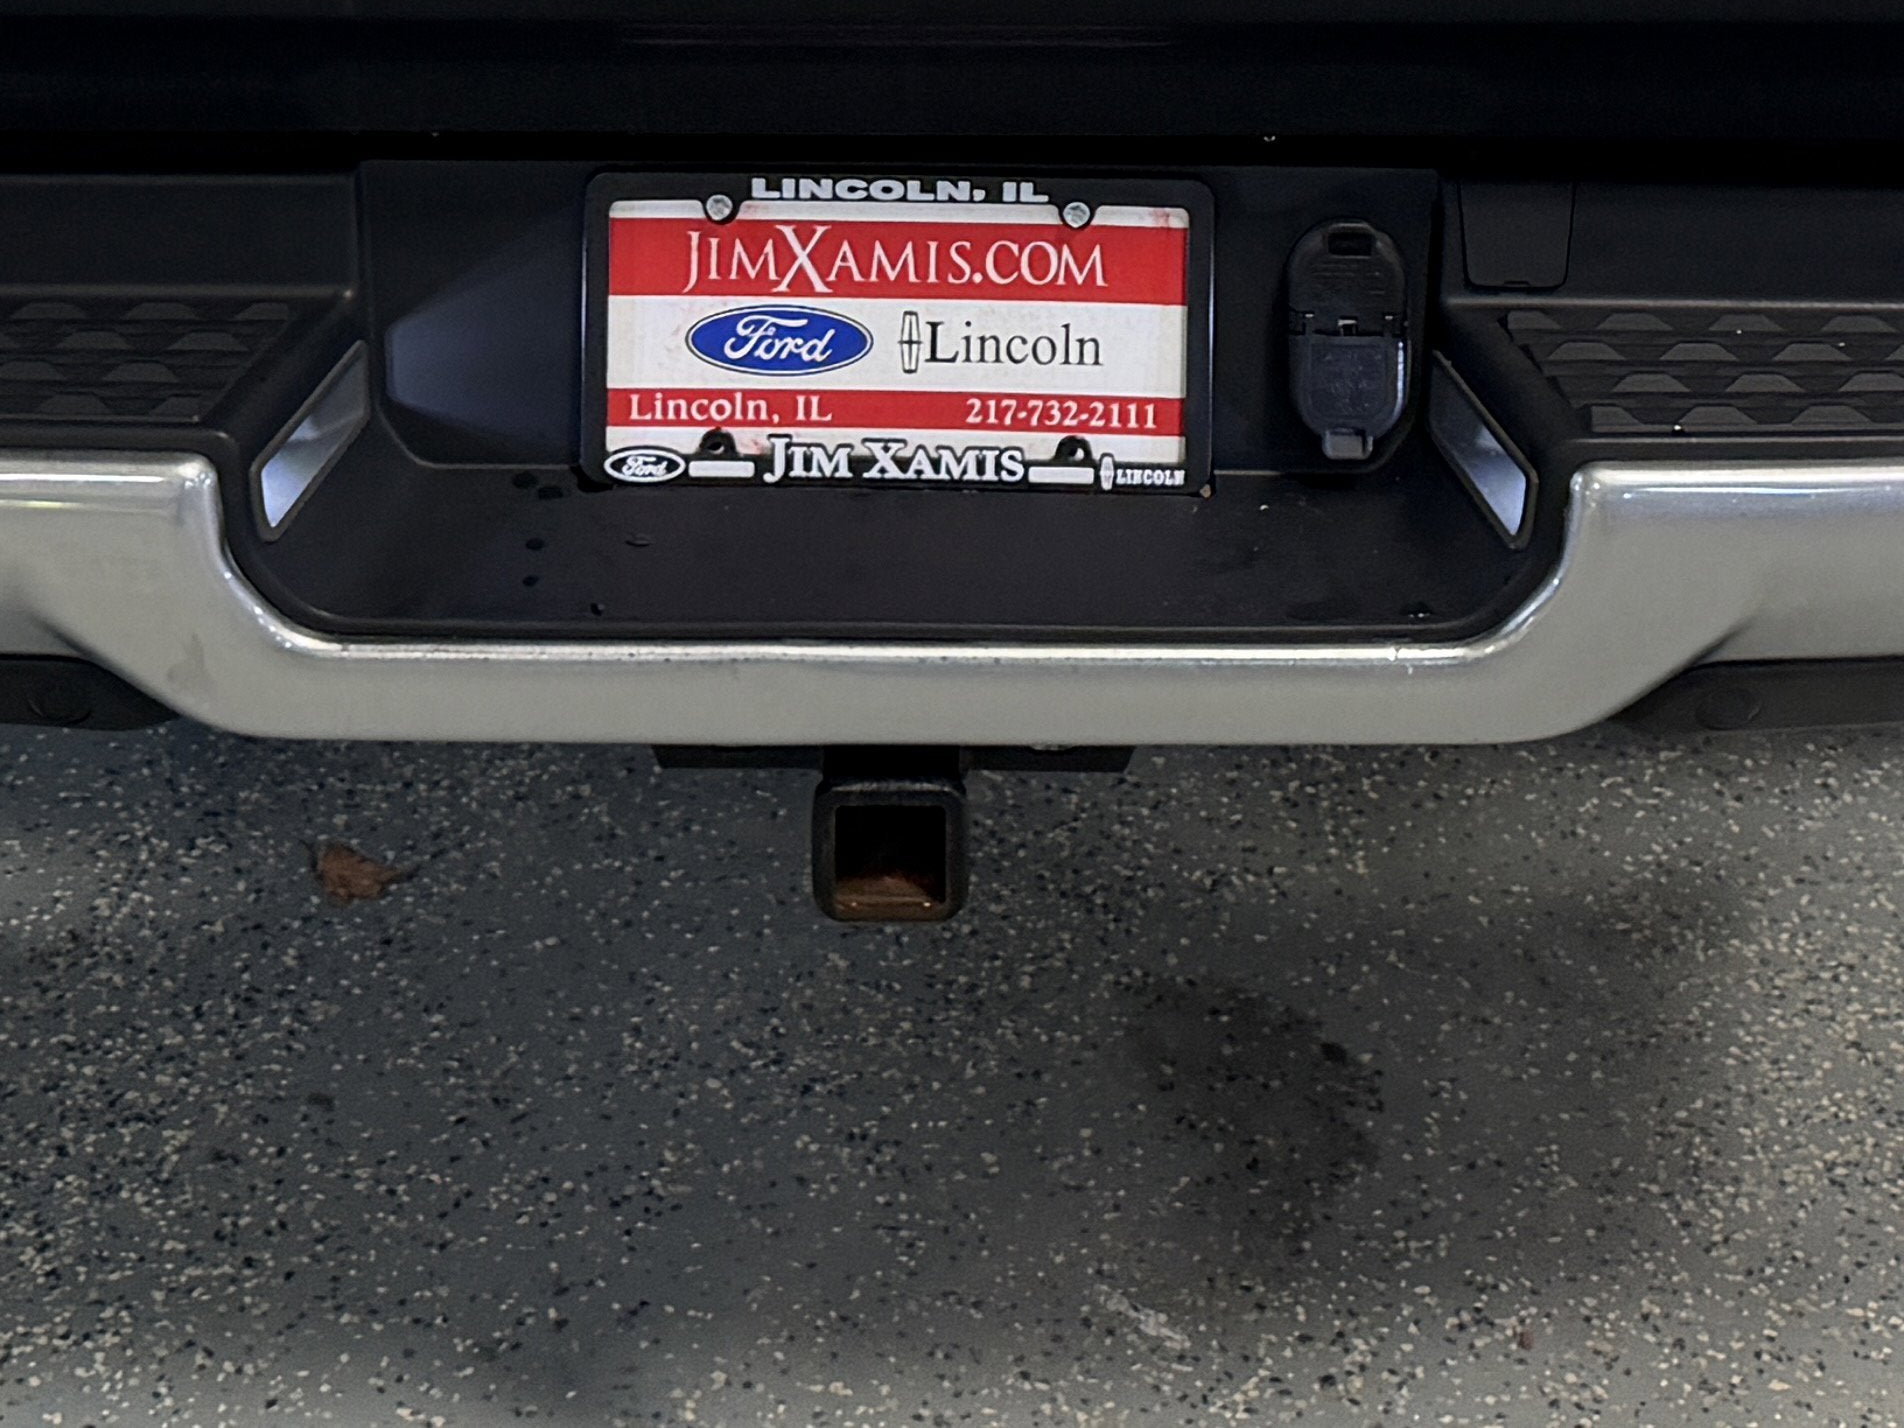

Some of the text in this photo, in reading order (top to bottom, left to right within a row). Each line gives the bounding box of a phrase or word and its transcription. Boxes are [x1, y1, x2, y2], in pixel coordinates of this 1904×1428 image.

[751, 178, 1048, 204] LINCOLN, IL
[683, 224, 1108, 294] JIMXAMIS.COM
[724, 314, 835, 364] Ford
[924, 321, 1103, 367] Lincoln
[629, 393, 833, 424] Lincoln, IL
[965, 398, 1156, 429] 217-732-2111
[622, 455, 667, 477] Ford
[763, 436, 1025, 484] JIM XAMIS
[1116, 468, 1185, 486] LINCOLN
